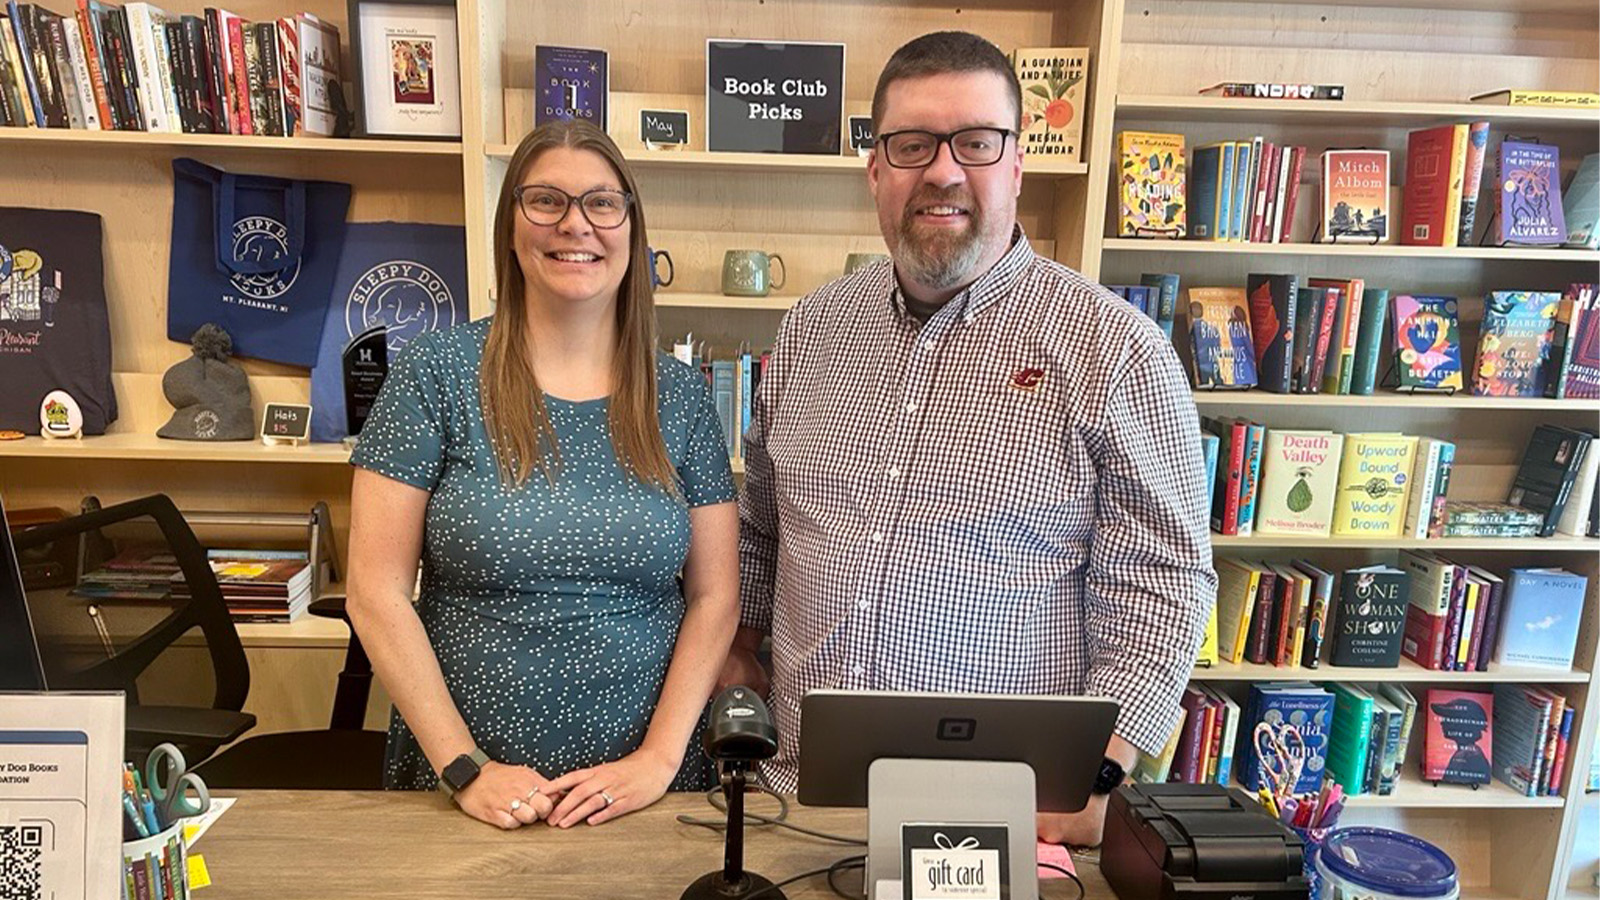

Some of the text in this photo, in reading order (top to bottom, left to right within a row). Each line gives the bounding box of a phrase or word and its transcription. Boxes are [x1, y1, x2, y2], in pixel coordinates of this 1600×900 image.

[263, 41, 273, 66] TENDER
[1021, 58, 1083, 68] A GUARDIAN
[246, 51, 258, 91] WATERS
[266, 66, 275, 84] LAND
[1021, 71, 1082, 80] AND A THIEF
[551, 78, 590, 88] BOOK
[724, 76, 827, 97] Book Club
[81, 83, 94, 103] FORD
[546, 106, 593, 118] DOORS
[748, 102, 803, 121] Picks
[645, 116, 674, 138] May
[1026, 146, 1074, 154] AJUMDAR
[1339, 160, 1380, 174] Mitch
[1335, 176, 1383, 189] Albom
[1129, 184, 1182, 199] READING
[1518, 216, 1547, 226] JULIA
[232, 219, 273, 239] LEEPY
[1510, 226, 1560, 237] ALVAREZ
[353, 264, 450, 305] SLEEPY DOG
[222, 295, 236, 303] MT.
[1420, 304, 1439, 312] THE
[1400, 316, 1458, 327] VANISHING
[1493, 318, 1555, 327] ELIZABETH
[1201, 321, 1247, 339] BACKMAN
[1507, 330, 1534, 338] BERG
[1506, 360, 1534, 368] LOVE
[1408, 369, 1455, 378] BENNETT
[1496, 370, 1530, 379] STORY
[274, 409, 298, 421] Hats
[273, 423, 288, 434] $15
[1283, 434, 1329, 449] Death
[1282, 450, 1328, 465] Valley
[1356, 444, 1408, 458] Upward
[1247, 440, 1259, 488] BLUE SKIES
[1359, 461, 1399, 473] Bound
[1350, 500, 1396, 515] Woody
[1297, 520, 1325, 530] Broder
[1350, 518, 1390, 530] Brown
[1519, 577, 1537, 586] DAY
[1552, 581, 1582, 590] NOVEL
[1355, 584, 1399, 599] ONE
[1345, 601, 1406, 616] WOMAN
[1343, 620, 1402, 635] SHOW
[1282, 701, 1319, 709] Loneliness
[928, 858, 984, 891] gift card
